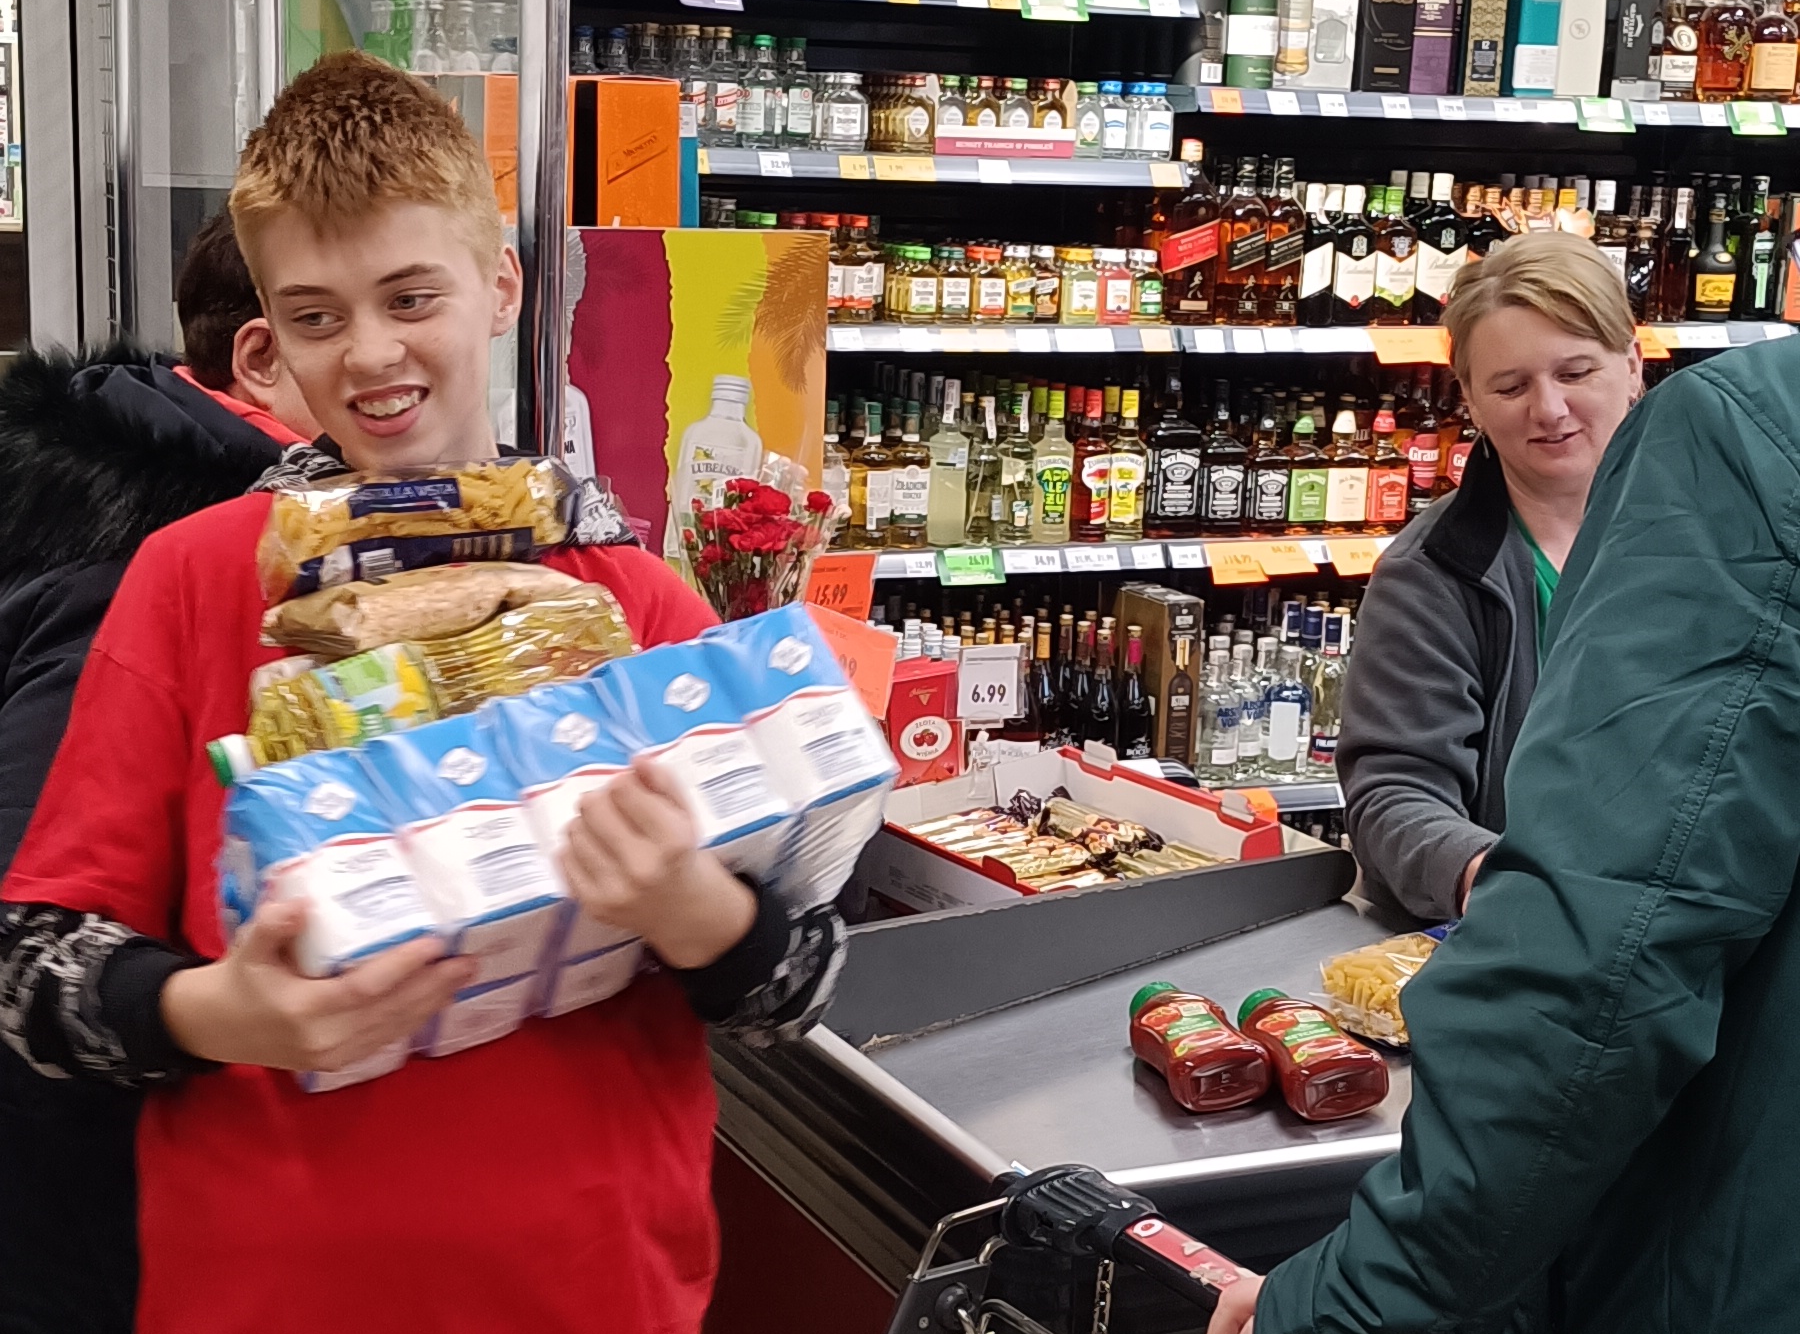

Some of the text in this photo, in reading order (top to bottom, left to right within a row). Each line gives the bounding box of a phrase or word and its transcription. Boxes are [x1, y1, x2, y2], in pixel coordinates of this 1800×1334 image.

[814, 584, 848, 605] 15.99
[971, 684, 1007, 704] 6.99
[915, 718, 936, 729] ZŁOTA
[916, 747, 940, 758] WIŚNIA
